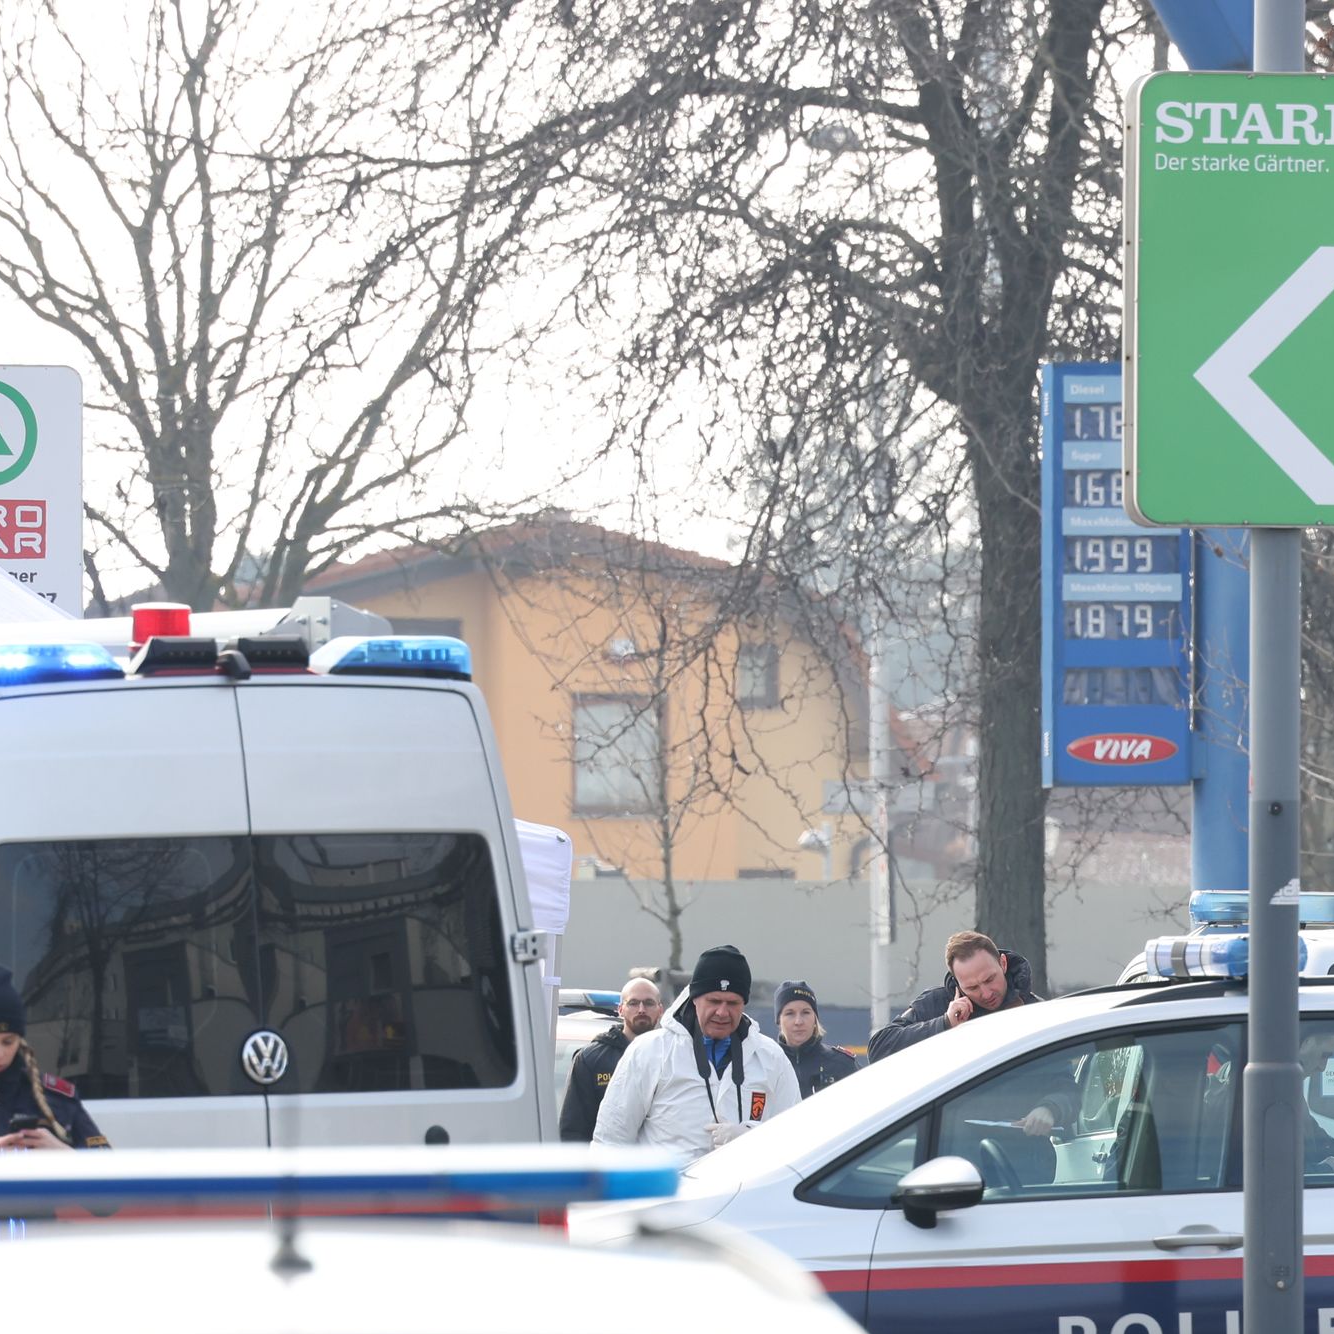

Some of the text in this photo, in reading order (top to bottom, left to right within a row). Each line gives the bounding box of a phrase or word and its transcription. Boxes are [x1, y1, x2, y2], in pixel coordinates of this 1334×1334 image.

[1155, 153, 1330, 173] Der starke Gärtner.
[1070, 384, 1105, 395] Diesel
[1093, 738, 1153, 760] VIVA
